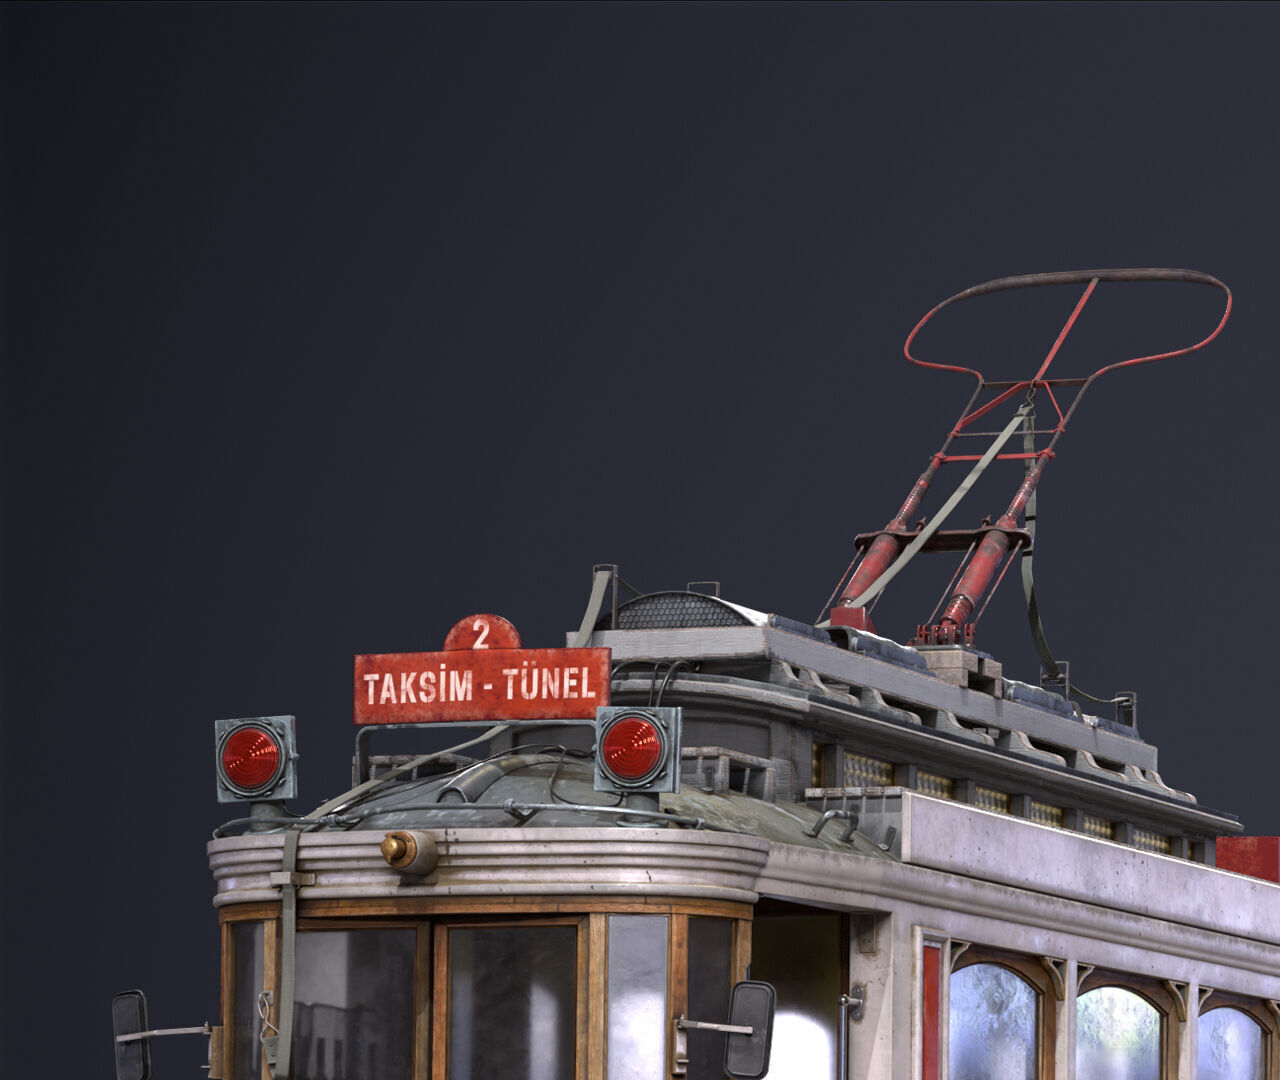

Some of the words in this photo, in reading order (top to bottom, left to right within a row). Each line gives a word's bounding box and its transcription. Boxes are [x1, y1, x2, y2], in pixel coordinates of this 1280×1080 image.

[472, 619, 490, 650] 2
[363, 663, 473, 705] TAKSİM
[502, 661, 596, 700] TÜNEL
